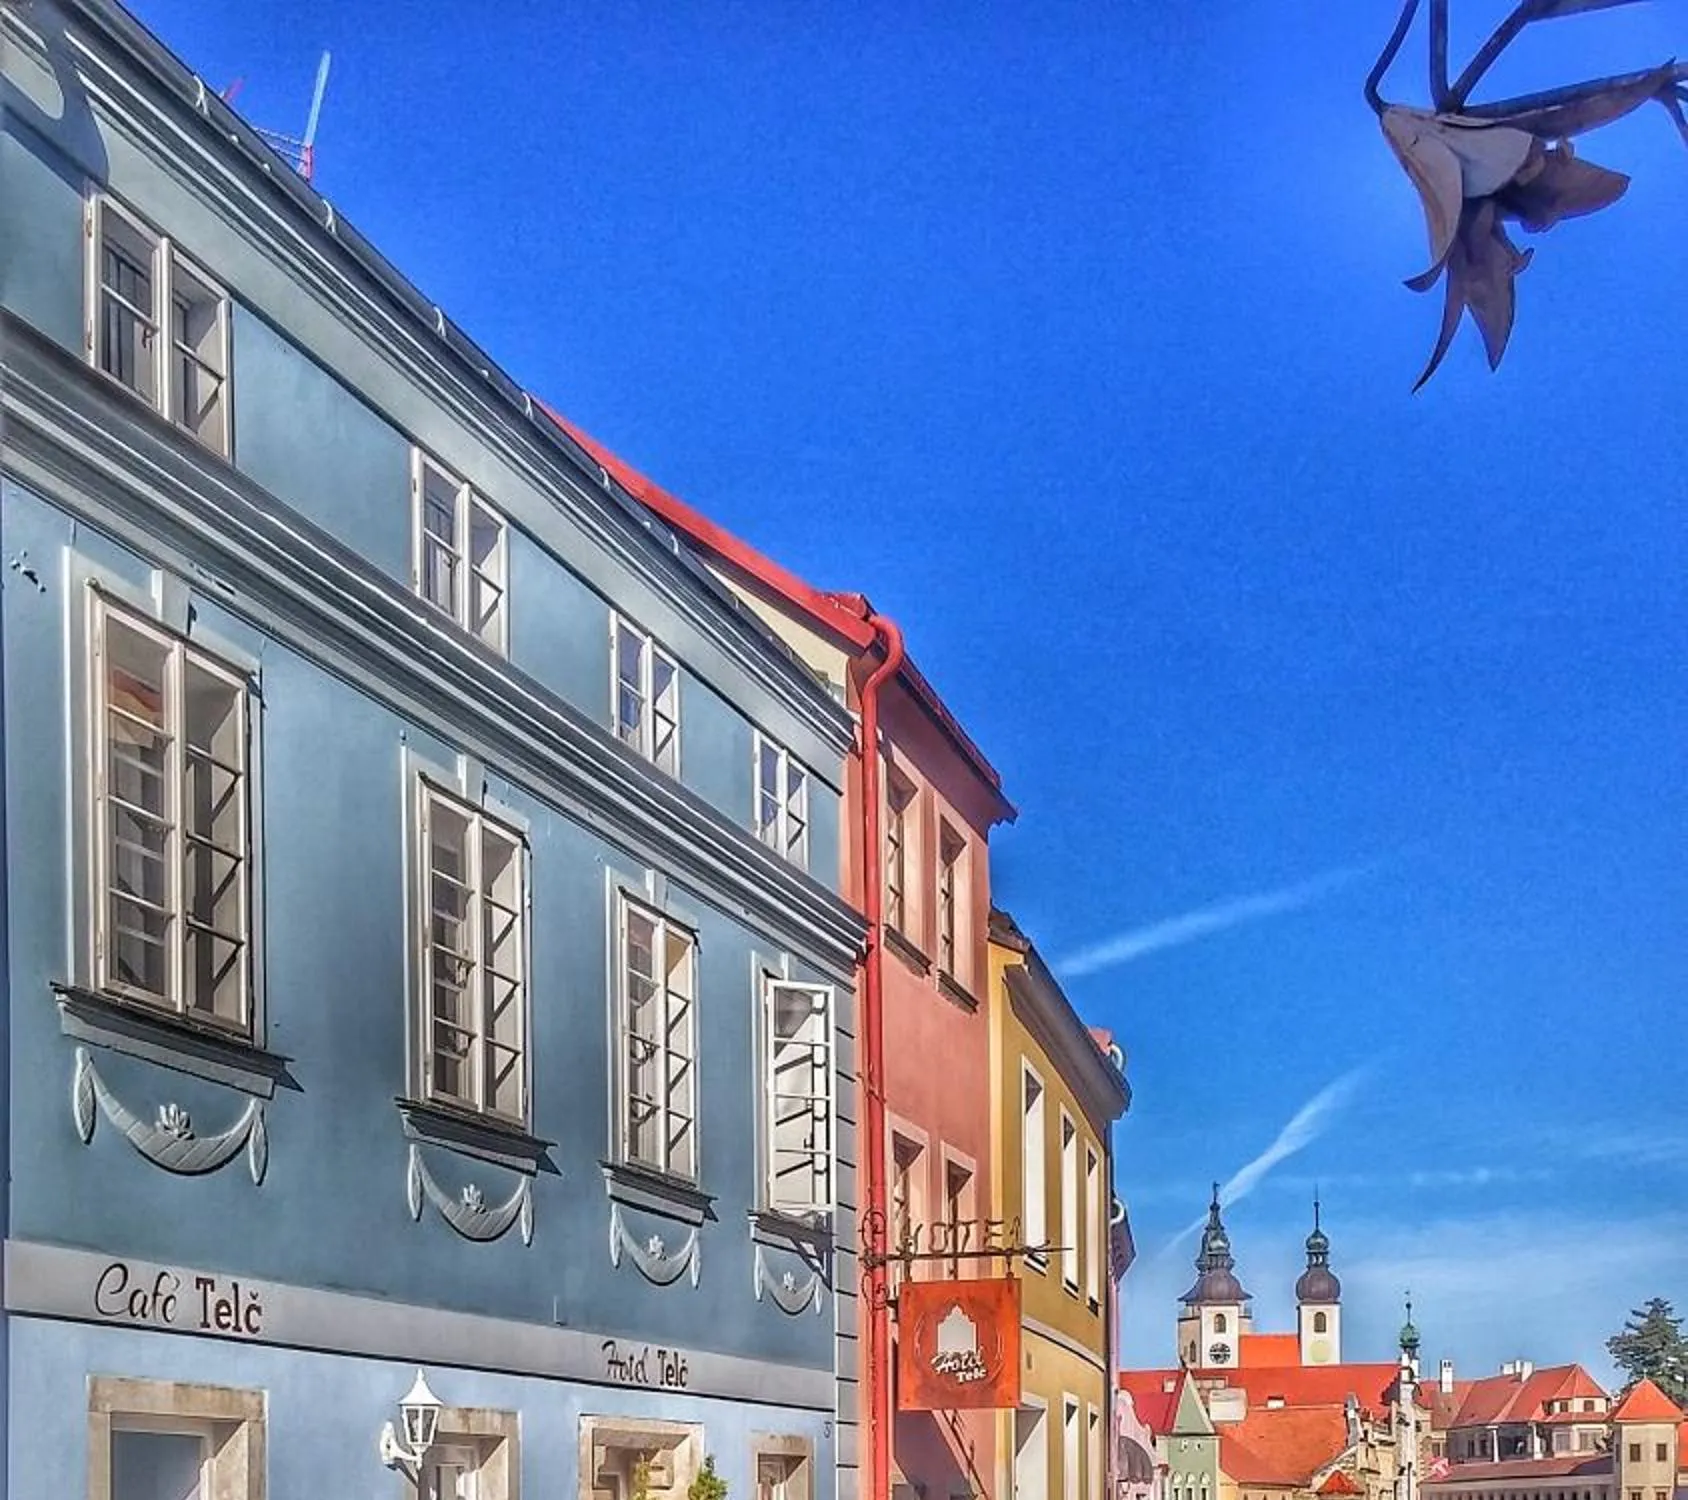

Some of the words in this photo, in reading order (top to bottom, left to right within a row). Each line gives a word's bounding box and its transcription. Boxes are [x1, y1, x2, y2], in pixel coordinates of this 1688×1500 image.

[95, 1263, 181, 1323] Café
[195, 1276, 263, 1334] Telč
[657, 1350, 689, 1387] Telč
